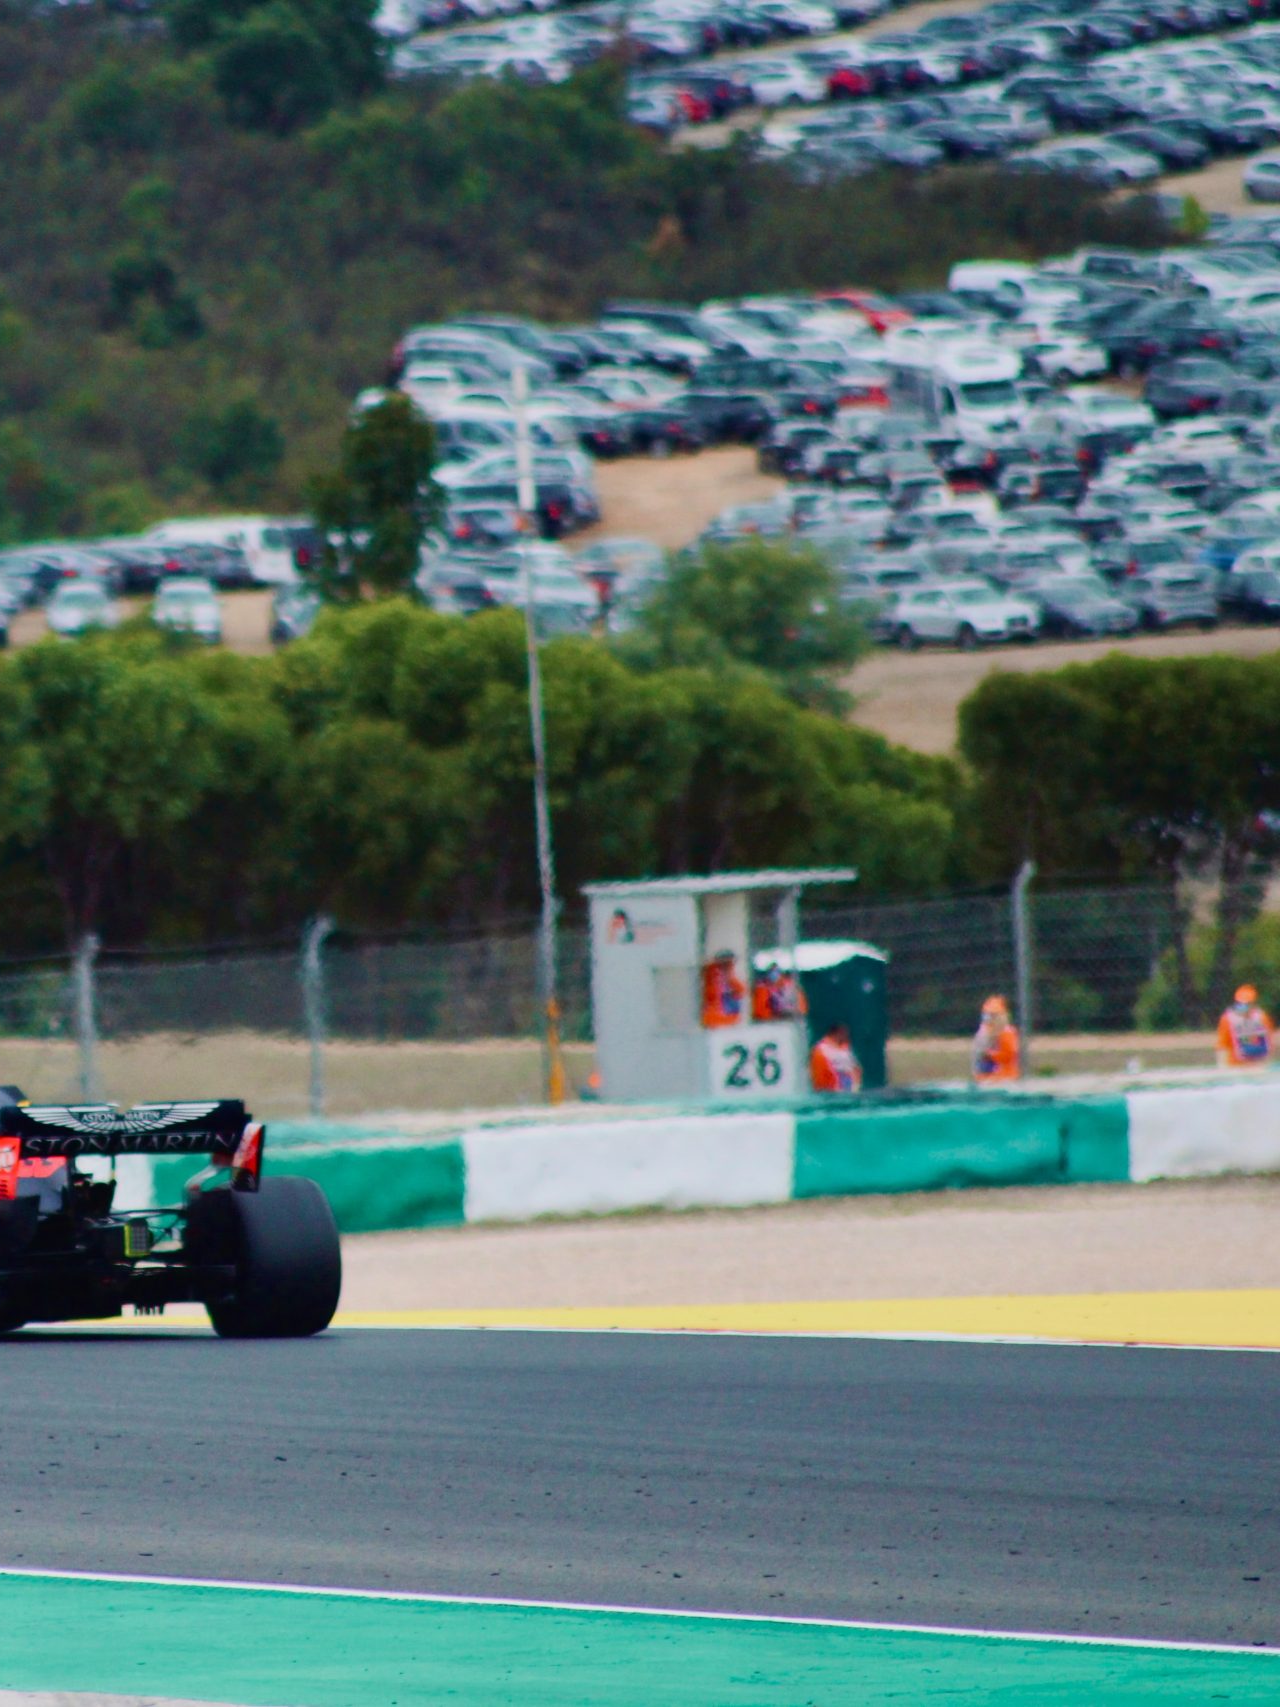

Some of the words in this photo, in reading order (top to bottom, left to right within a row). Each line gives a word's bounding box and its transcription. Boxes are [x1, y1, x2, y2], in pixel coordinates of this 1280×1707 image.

[722, 1042, 782, 1087] 26
[82, 1112, 117, 1123] ASTON
[123, 1110, 161, 1122] MARTIN
[24, 1136, 111, 1152] STON
[117, 1131, 237, 1151] MARTIN
